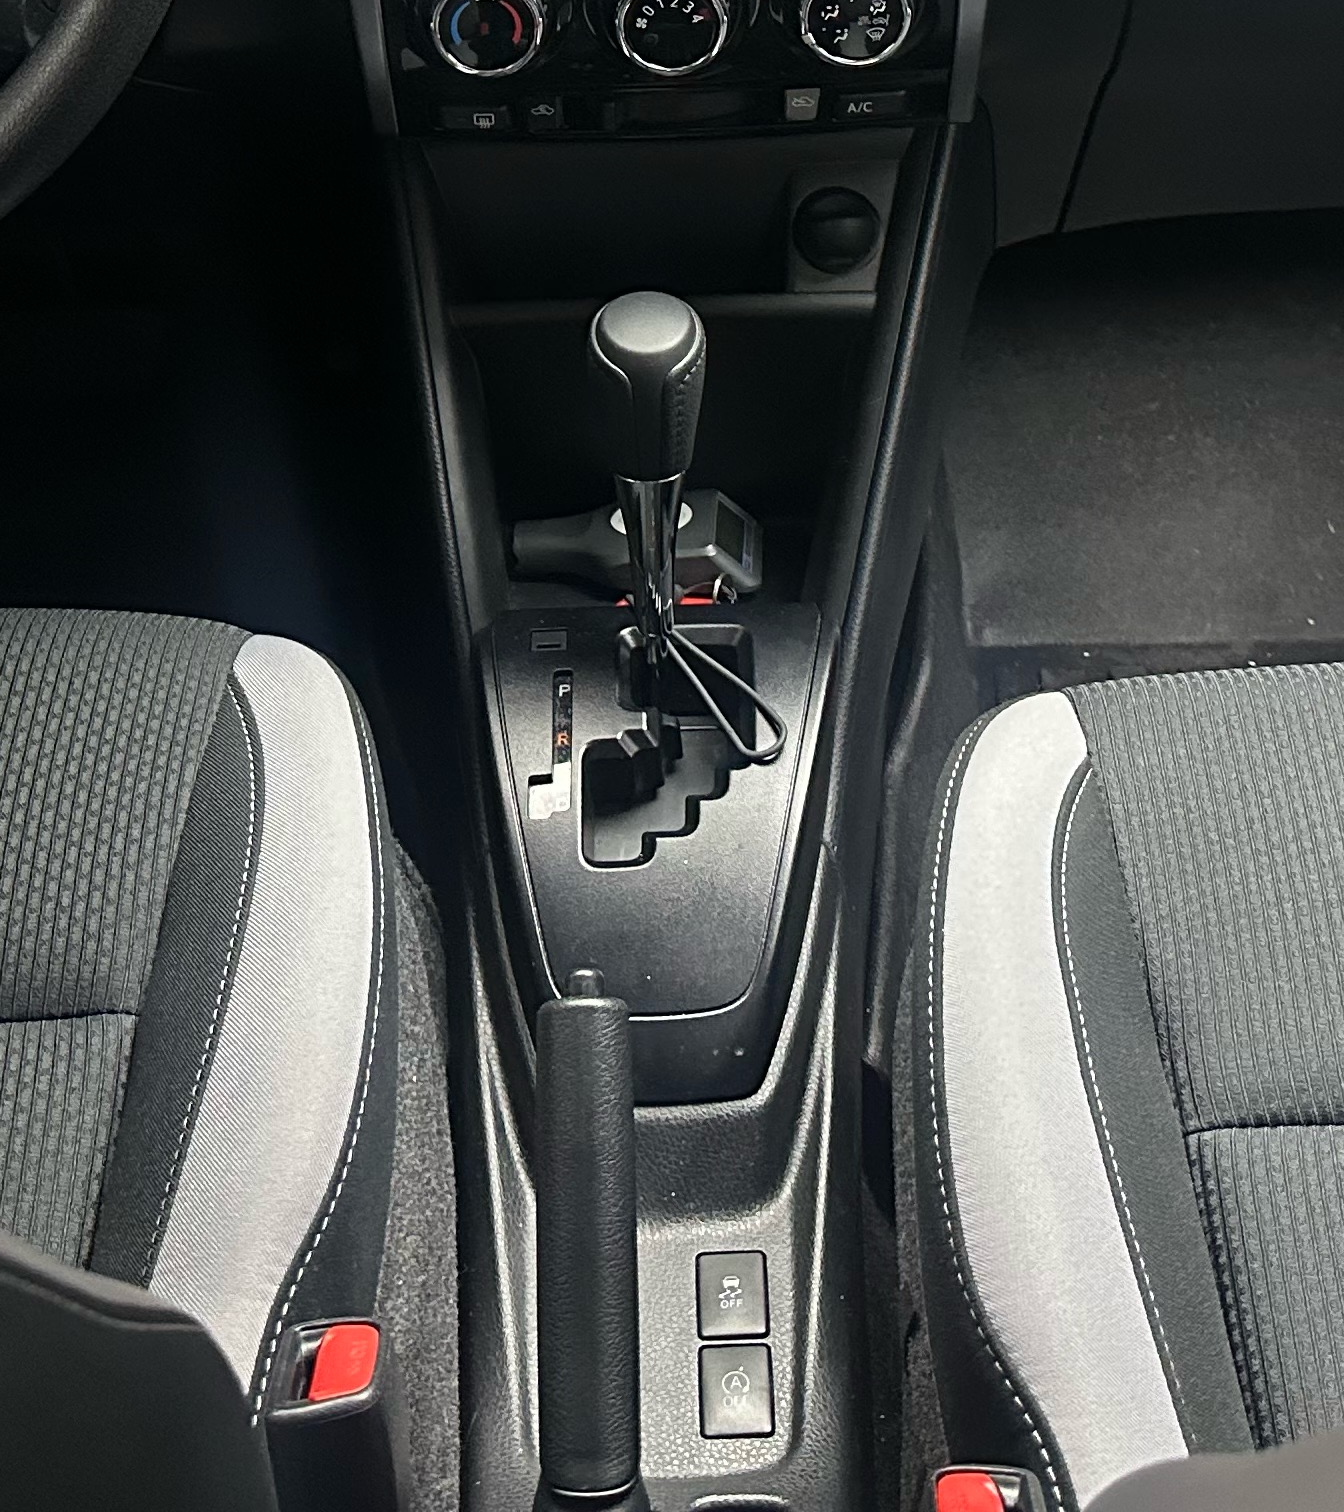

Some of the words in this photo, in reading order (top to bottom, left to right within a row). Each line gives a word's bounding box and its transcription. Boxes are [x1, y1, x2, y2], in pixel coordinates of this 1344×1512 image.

[641, 5, 655, 17] 0
[682, 0, 695, 14] 3
[691, 14, 705, 24] 4
[847, 101, 873, 114] A/C
[558, 683, 571, 697] P
[557, 732, 569, 746] R
[719, 1298, 744, 1309] OFF
